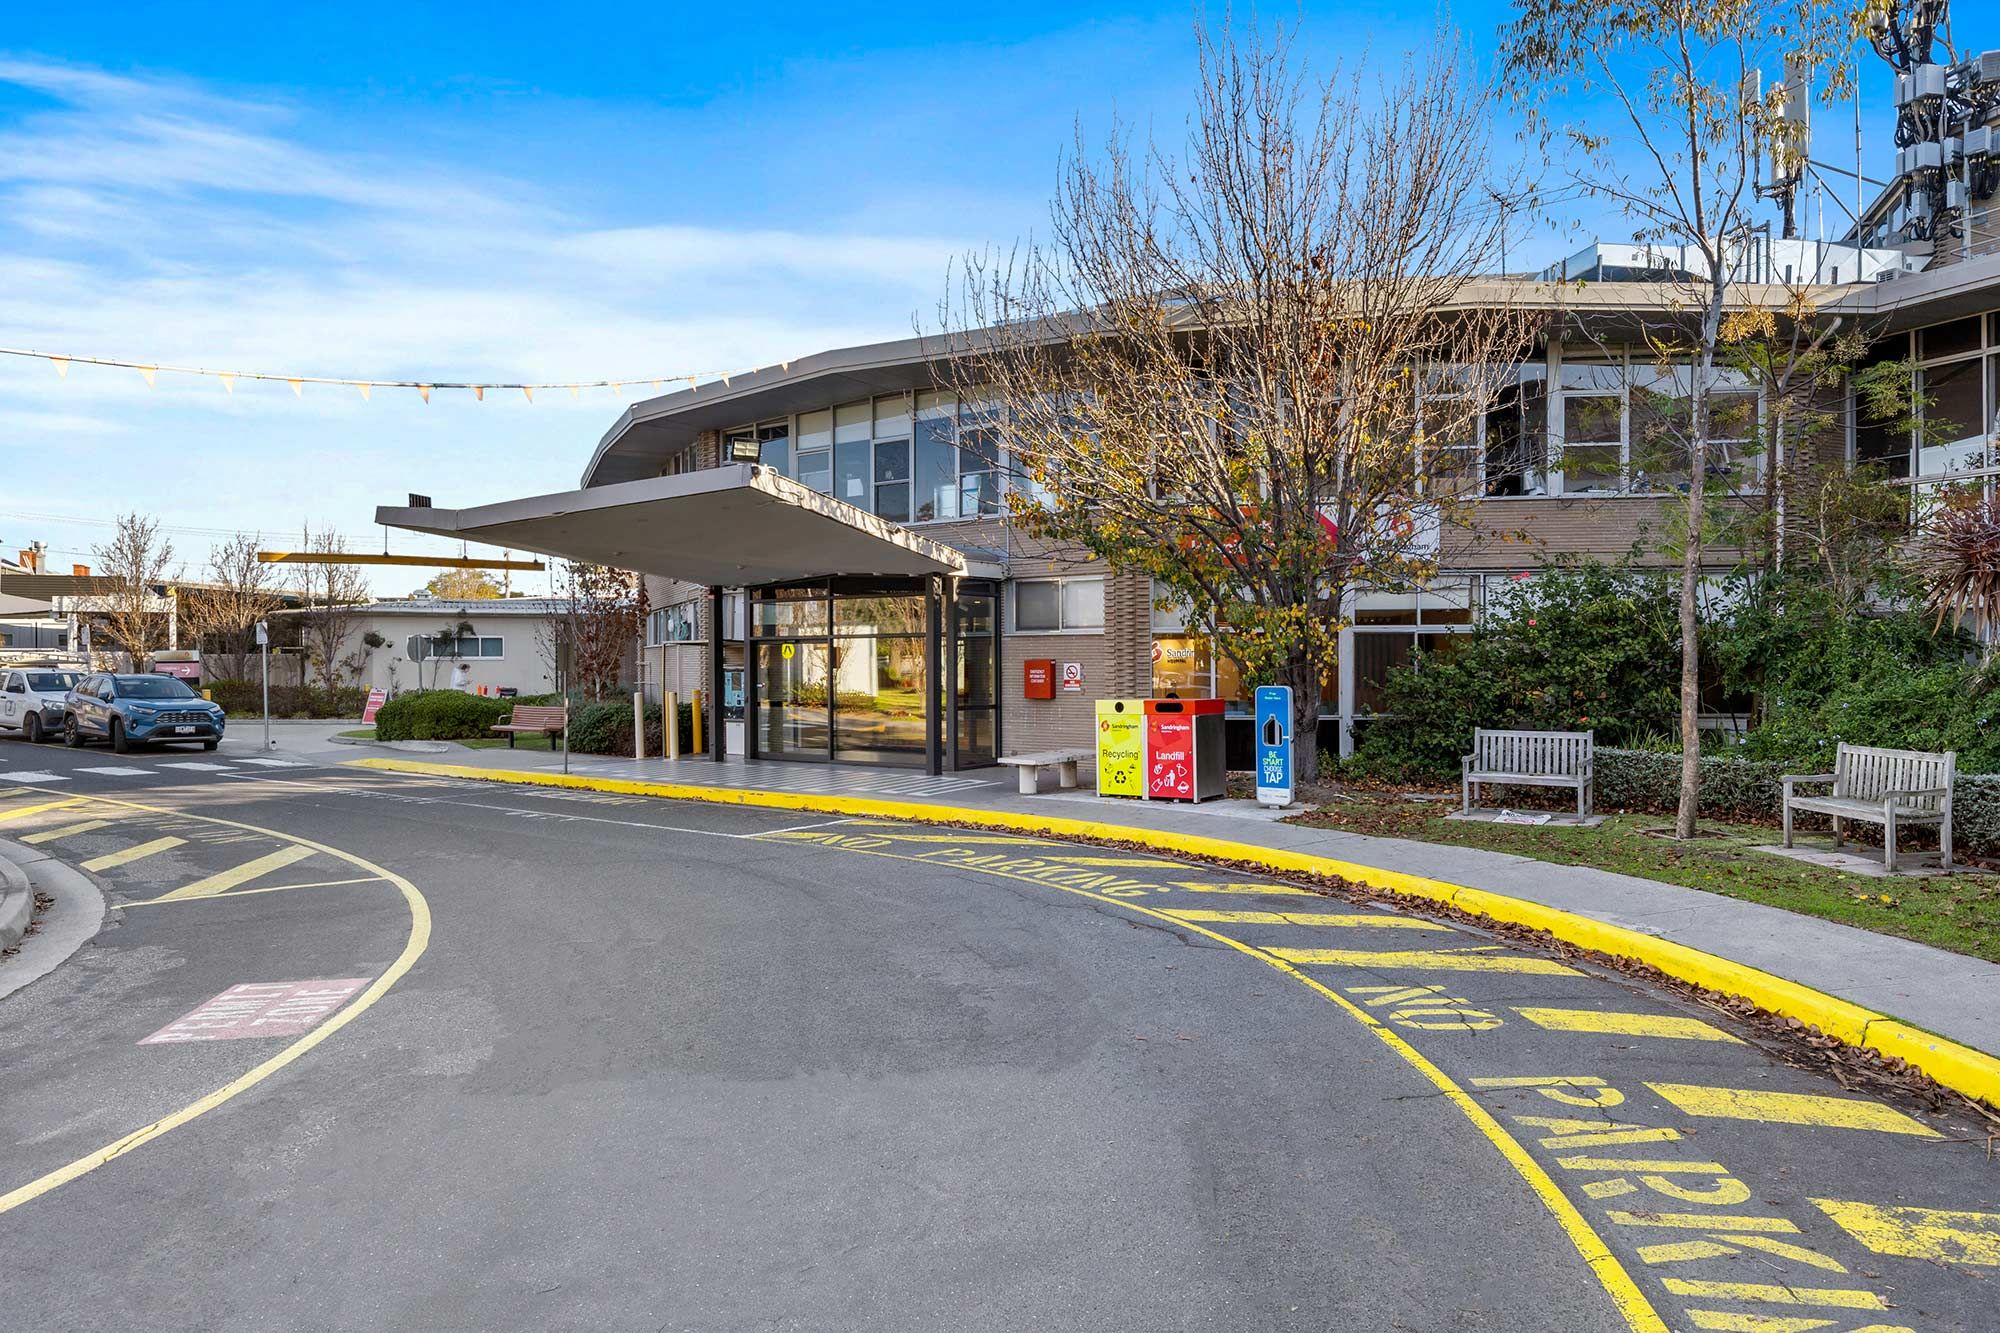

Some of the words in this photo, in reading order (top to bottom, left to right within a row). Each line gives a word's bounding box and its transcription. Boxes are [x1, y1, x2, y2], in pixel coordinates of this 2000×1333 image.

[1111, 723, 1139, 731] Sandringham
[1160, 723, 1190, 731] Sandringham
[1102, 749, 1139, 761] Recycling
[1155, 750, 1185, 761] Landfill
[1268, 750, 1277, 759] BE
[1262, 758, 1284, 766] SMART
[1264, 771, 1284, 784] TAP
[914, 848, 1171, 897] PARKING
[1344, 985, 1504, 1032] NO
